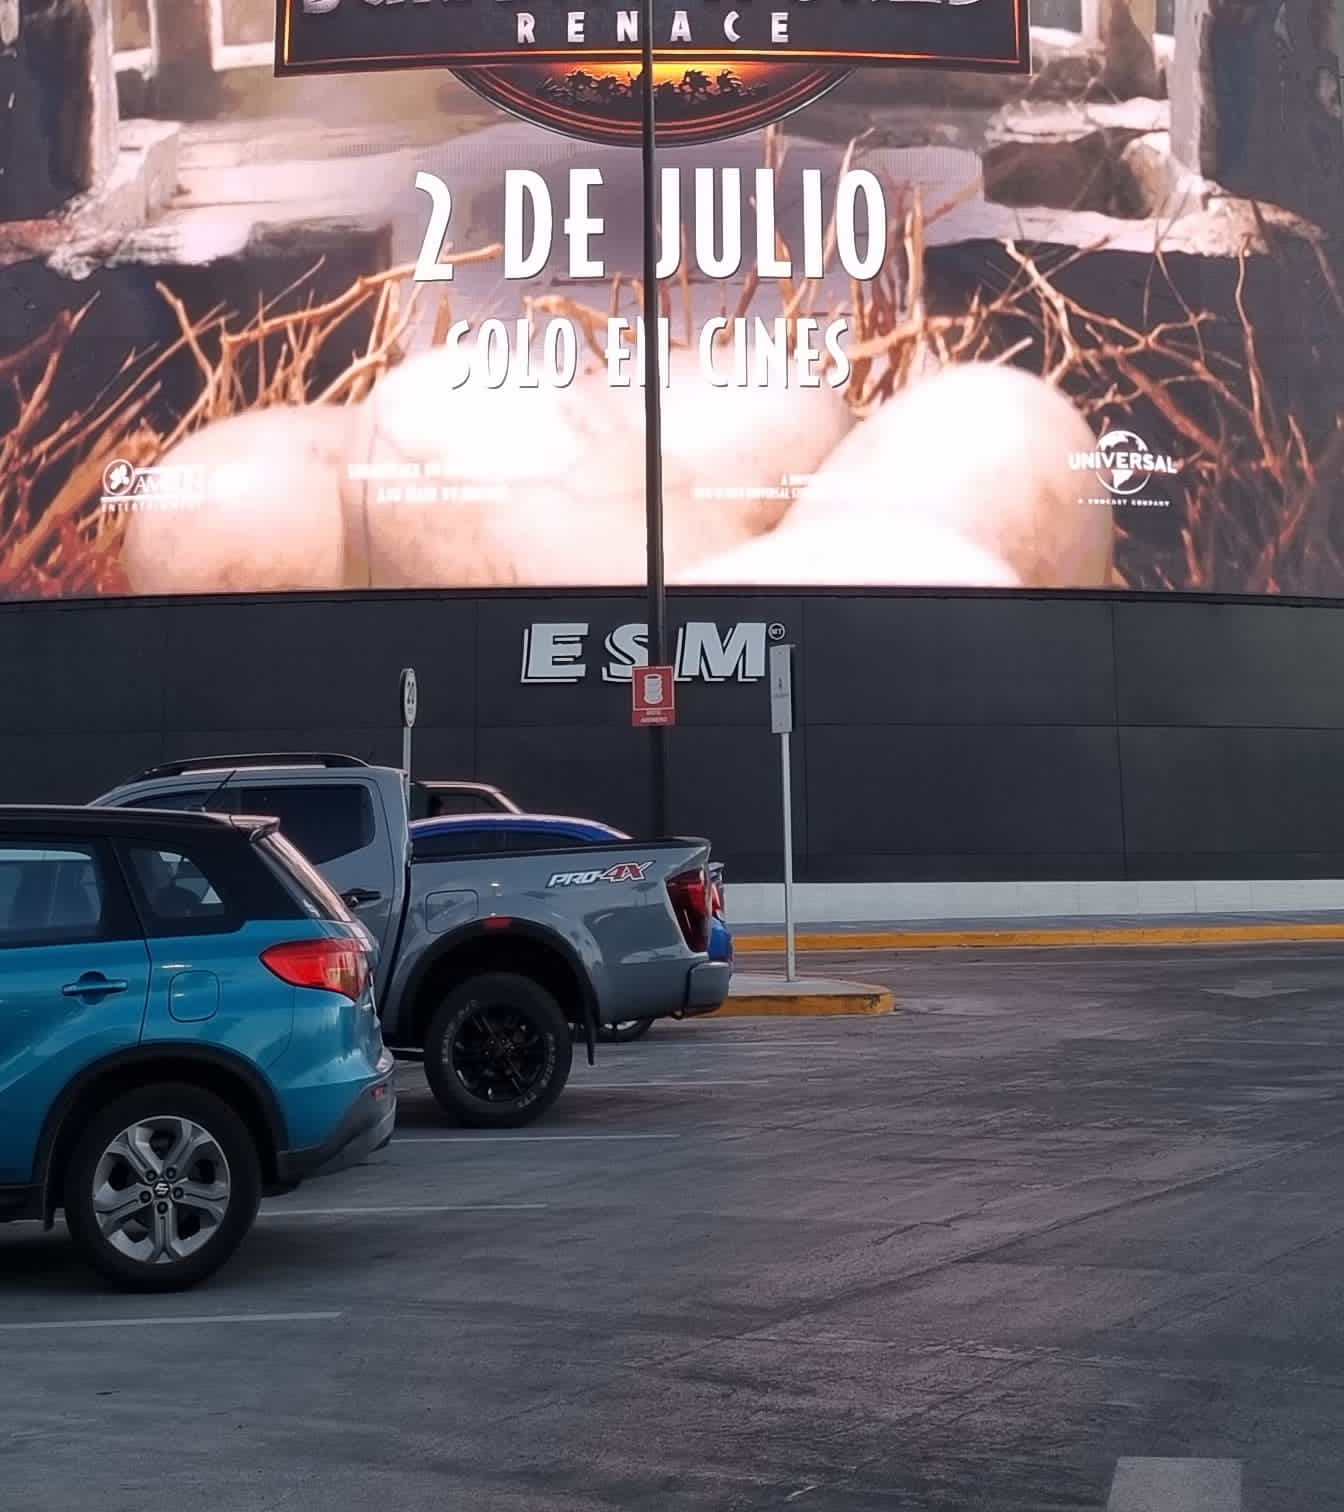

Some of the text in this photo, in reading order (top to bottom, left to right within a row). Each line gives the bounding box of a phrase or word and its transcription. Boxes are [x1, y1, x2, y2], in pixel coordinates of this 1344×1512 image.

[516, 10, 789, 44] RENACE
[412, 168, 887, 283] 2 DE JULIO
[445, 317, 578, 390] SOLO
[698, 317, 852, 389] CINES
[1069, 451, 1178, 474] UNIVERSAL
[521, 621, 767, 683] ESM
